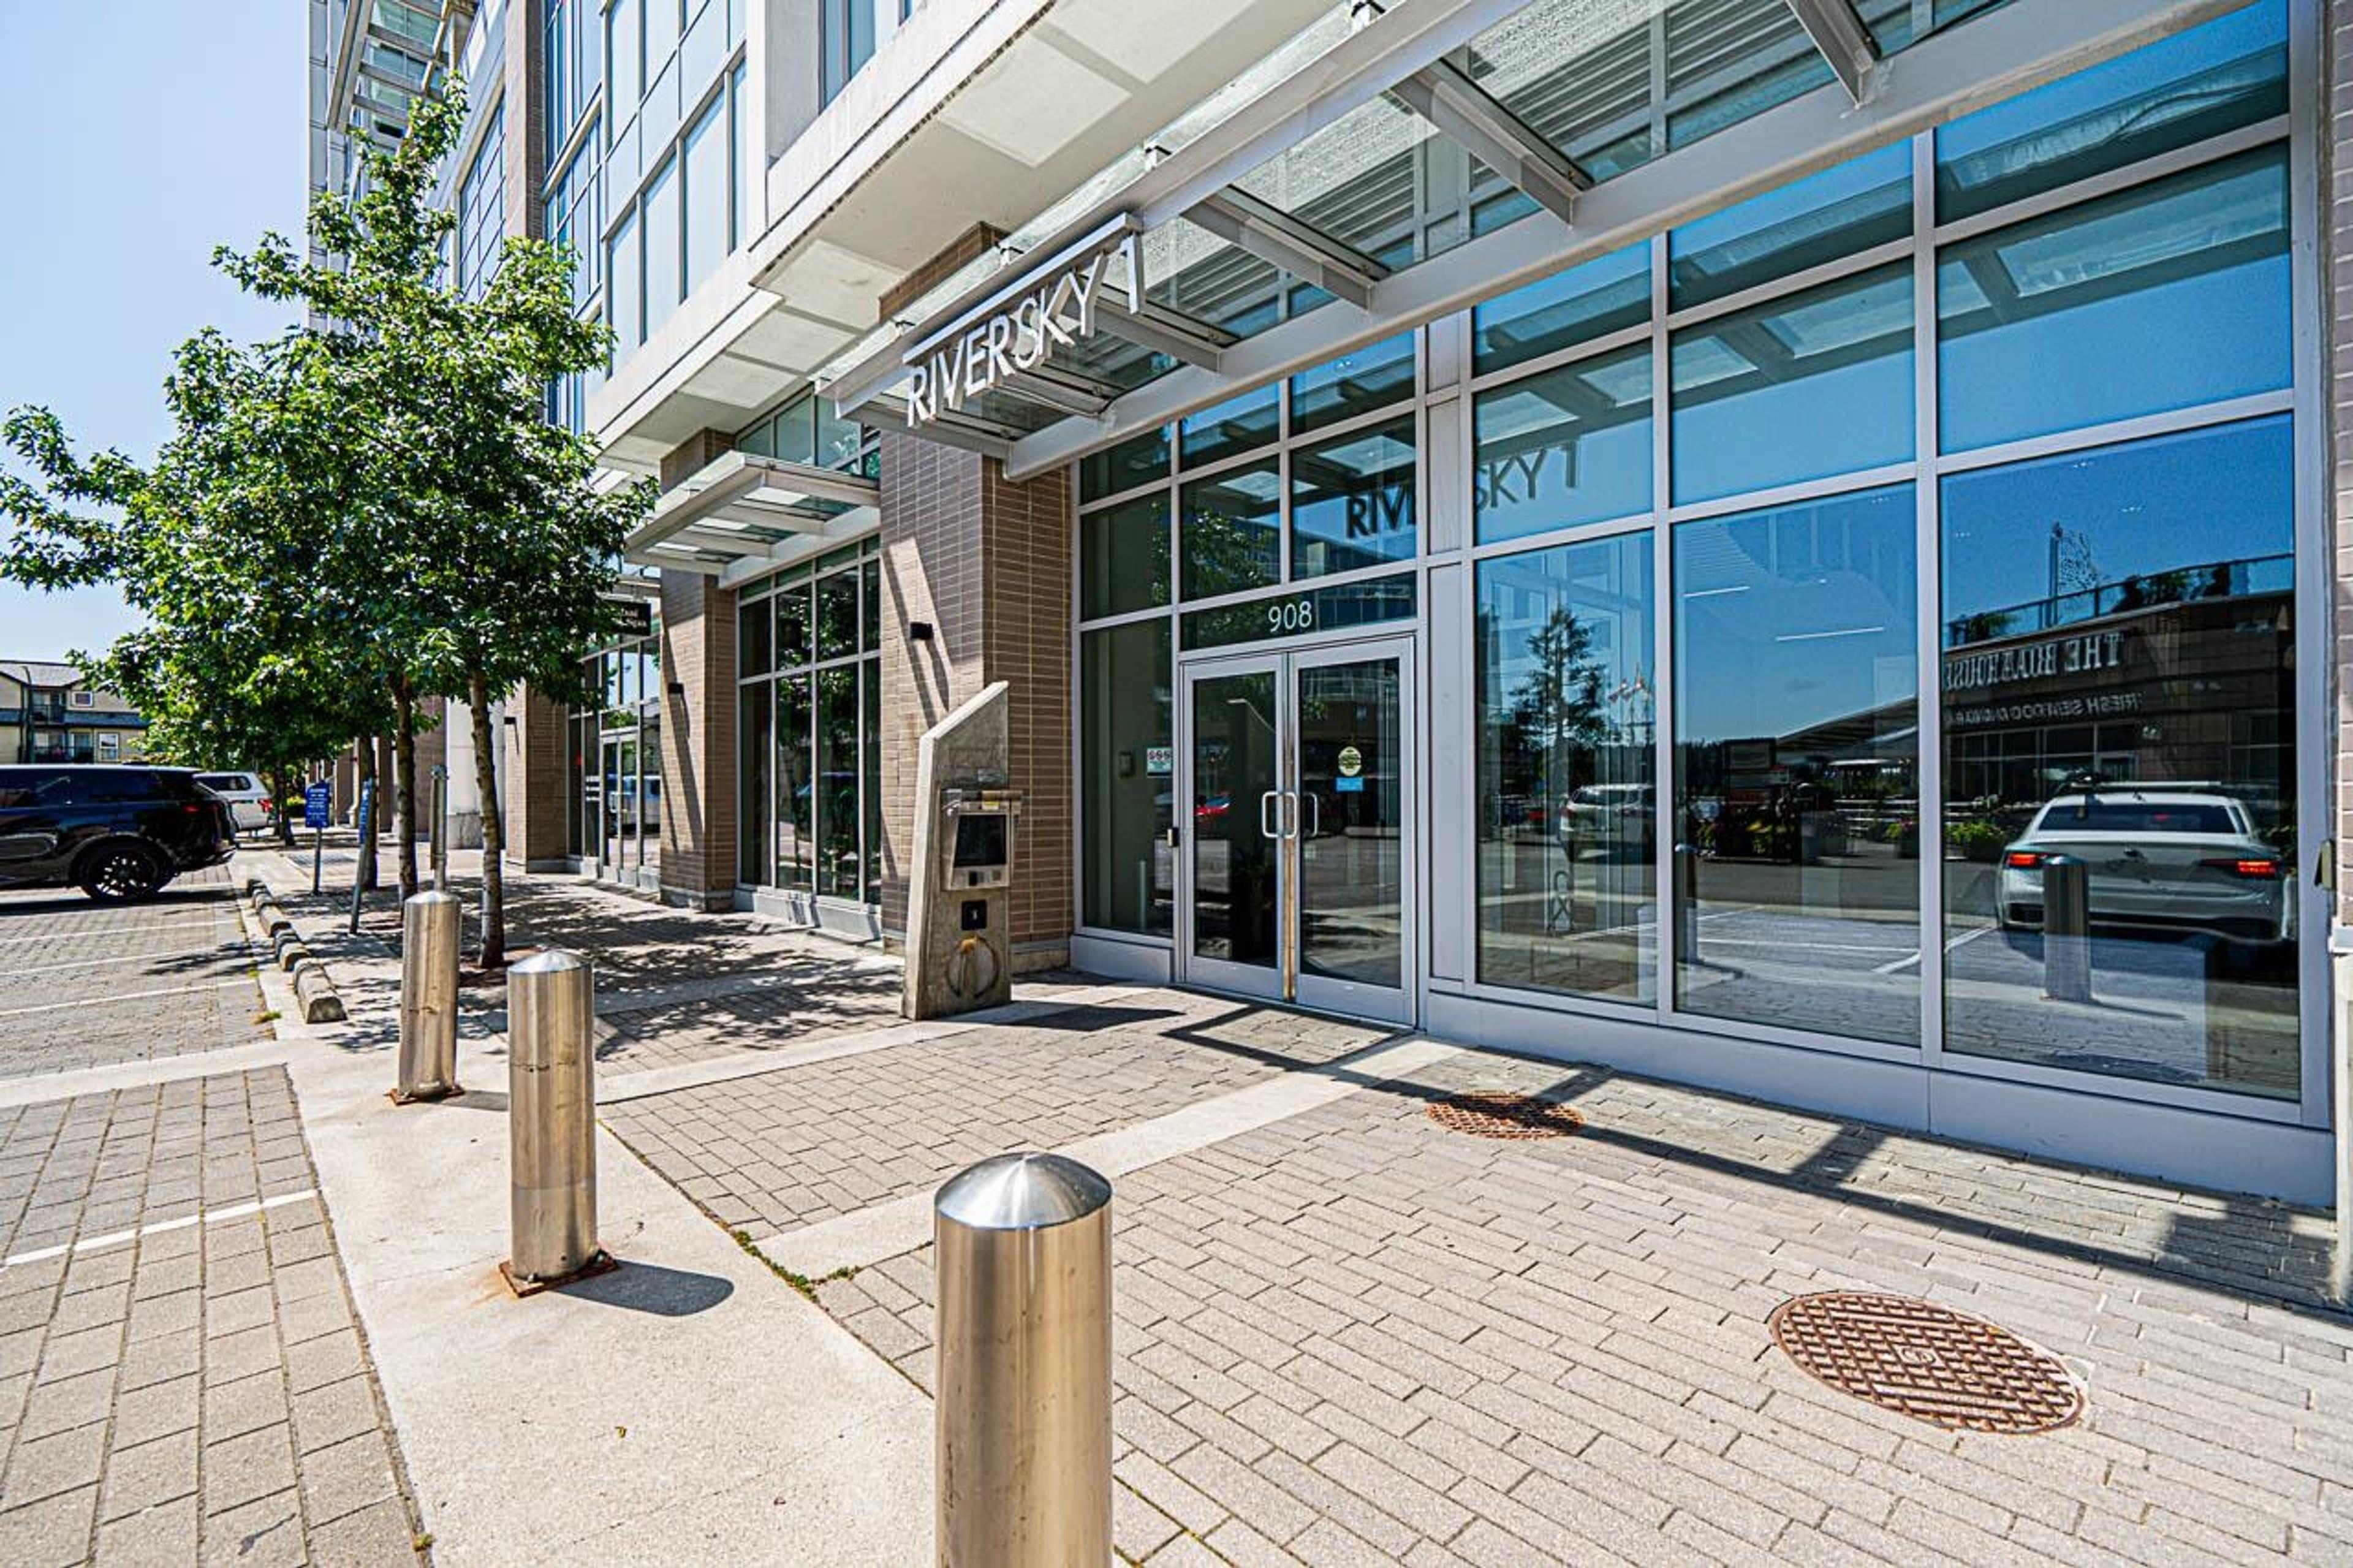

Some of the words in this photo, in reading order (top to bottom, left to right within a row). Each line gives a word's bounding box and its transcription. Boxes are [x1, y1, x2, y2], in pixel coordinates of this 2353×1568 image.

[907, 252, 1108, 428] RIVERSKY
[1120, 233, 1145, 314] 1
[1268, 600, 1313, 633] 908
